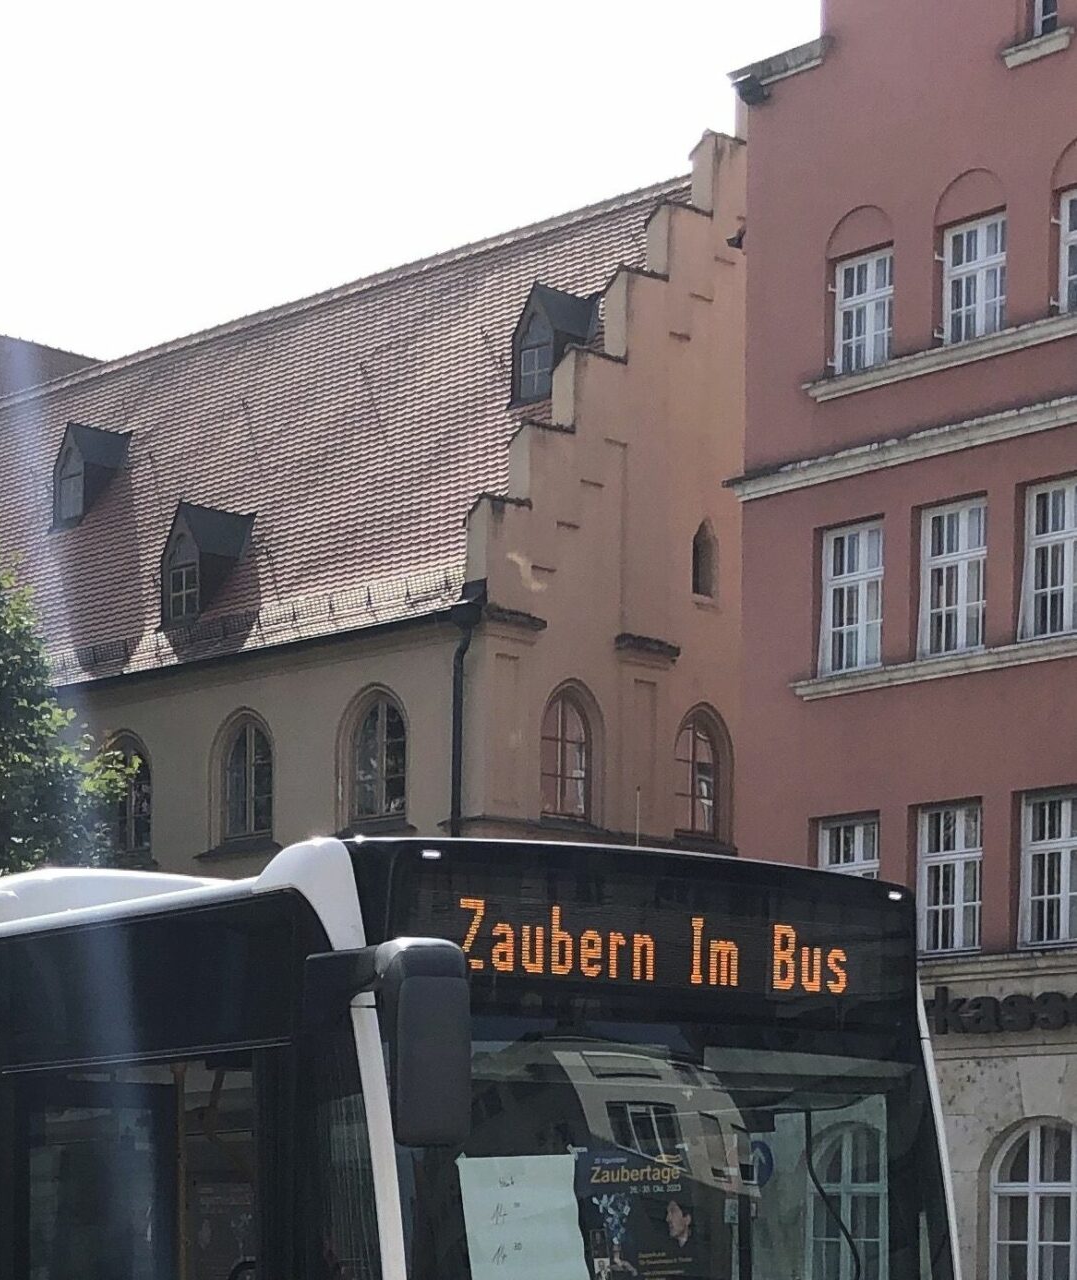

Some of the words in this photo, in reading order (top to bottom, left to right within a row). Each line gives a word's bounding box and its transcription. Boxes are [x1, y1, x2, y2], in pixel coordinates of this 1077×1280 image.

[459, 898, 655, 981] Zaubern
[690, 916, 739, 987] Im
[772, 923, 847, 993] Bus
[589, 1165, 681, 1185] Zaubertage
